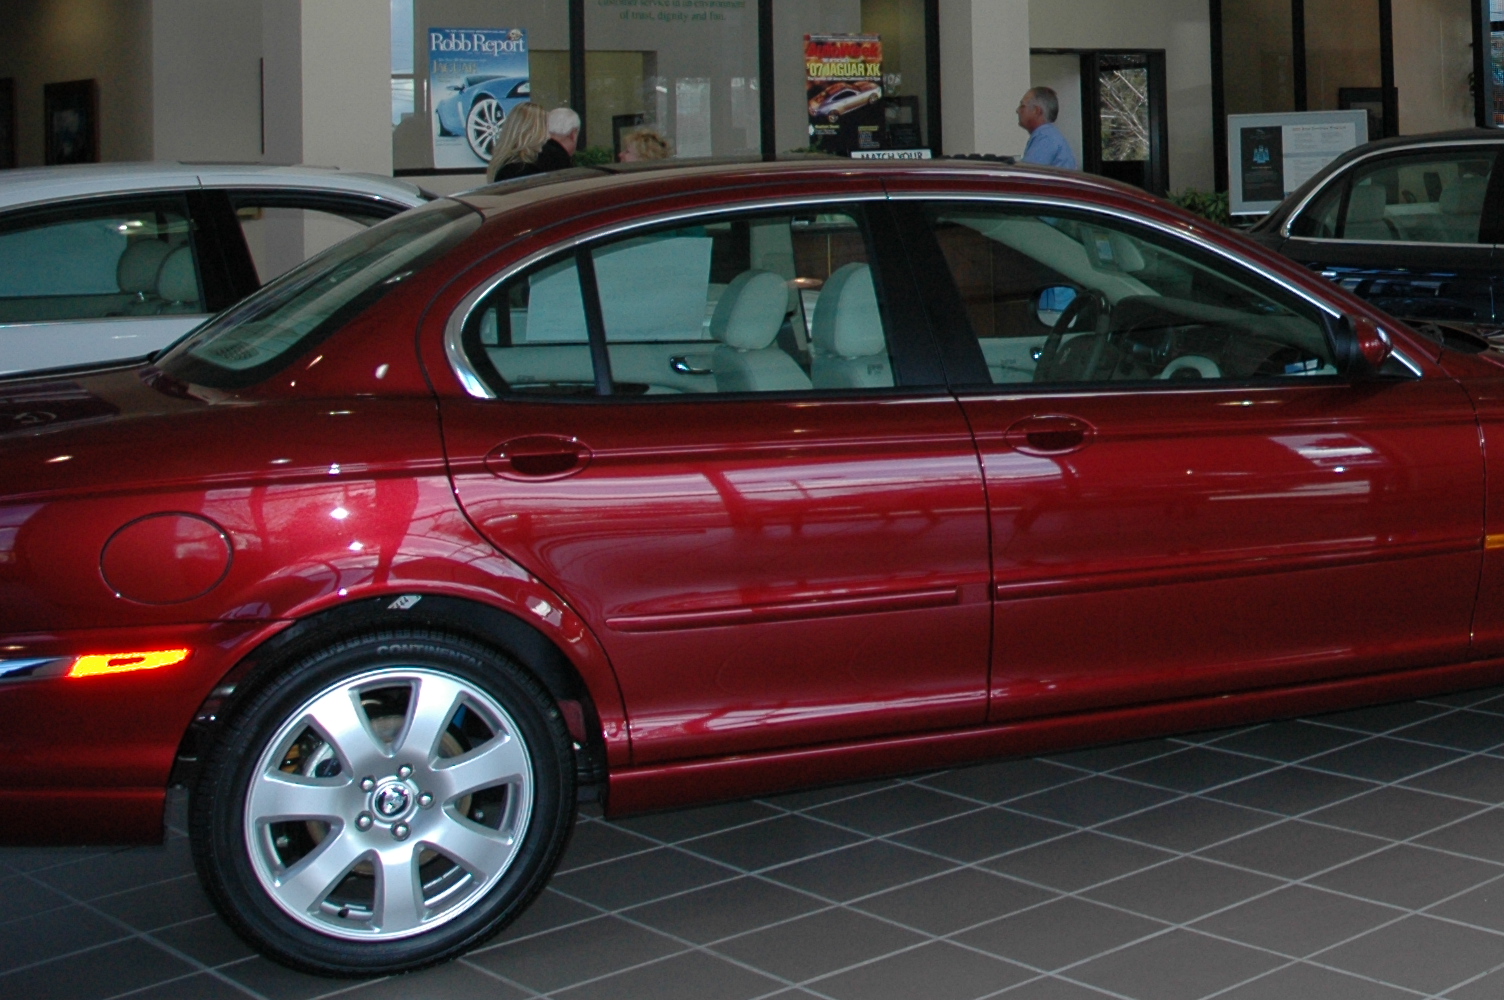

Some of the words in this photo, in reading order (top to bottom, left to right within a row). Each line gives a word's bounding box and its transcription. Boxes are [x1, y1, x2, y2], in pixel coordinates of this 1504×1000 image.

[694, 0, 746, 8] environment
[619, 10, 629, 20] of
[657, 11, 688, 23] dignity
[691, 11, 707, 21] and
[430, 32, 472, 52] Robb
[472, 33, 525, 56] Report
[823, 63, 865, 77] JAGUAR
[866, 63, 881, 77] XK
[861, 152, 895, 160] MATCH
[377, 643, 483, 668] CONTINENTAL
